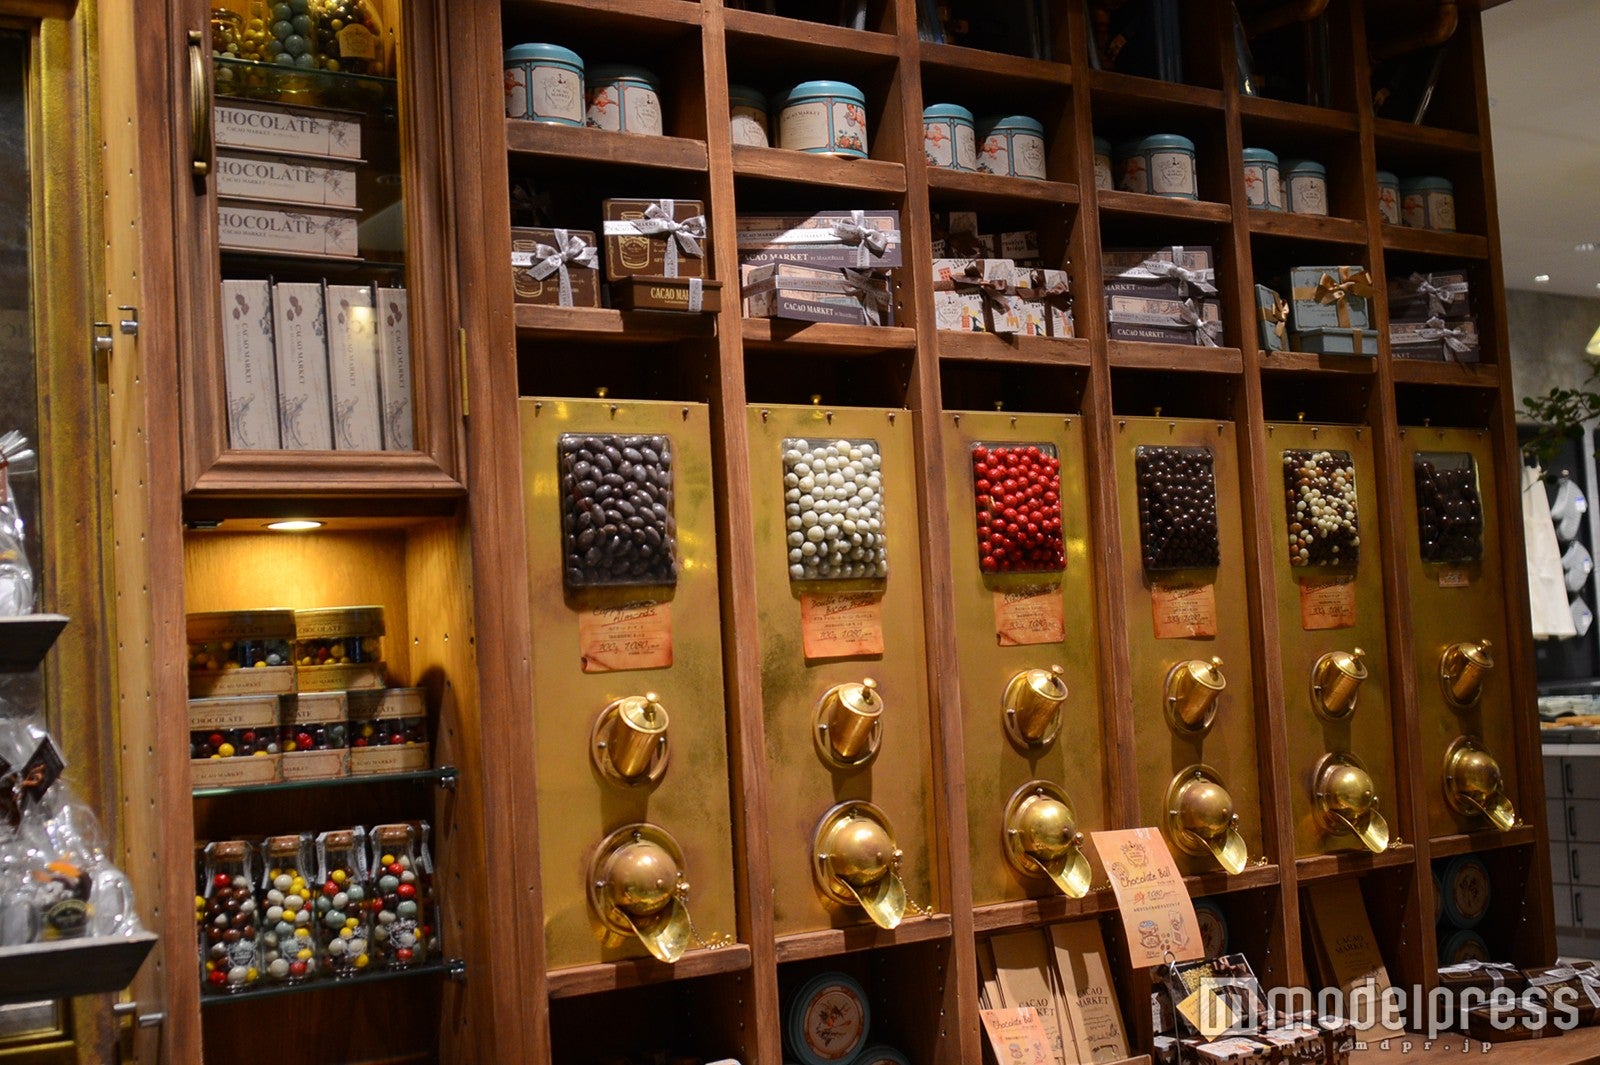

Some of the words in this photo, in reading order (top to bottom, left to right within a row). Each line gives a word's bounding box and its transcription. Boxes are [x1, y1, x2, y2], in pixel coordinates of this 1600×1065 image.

[216, 110, 320, 134] HOCOLATE
[217, 161, 316, 183] HOCOLATE
[218, 213, 316, 234] HOCOLATE
[770, 253, 808, 261] MARKET
[650, 287, 675, 300] CACAO
[783, 302, 806, 311] CACAO
[806, 305, 834, 316] MARKET
[1117, 328, 1138, 337] CACAO
[1138, 330, 1165, 339] MARKET
[191, 715, 243, 724] CHOCOLATE
[1120, 871, 1157, 888] Chocolate
[1157, 866, 1171, 878] Ball
[1077, 986, 1103, 998] CACAO
[1018, 998, 1048, 1008] CACAO
[1076, 995, 1109, 1008] MARKET
[1037, 1007, 1055, 1017] KET
[992, 1016, 1023, 1029] Chocolate
